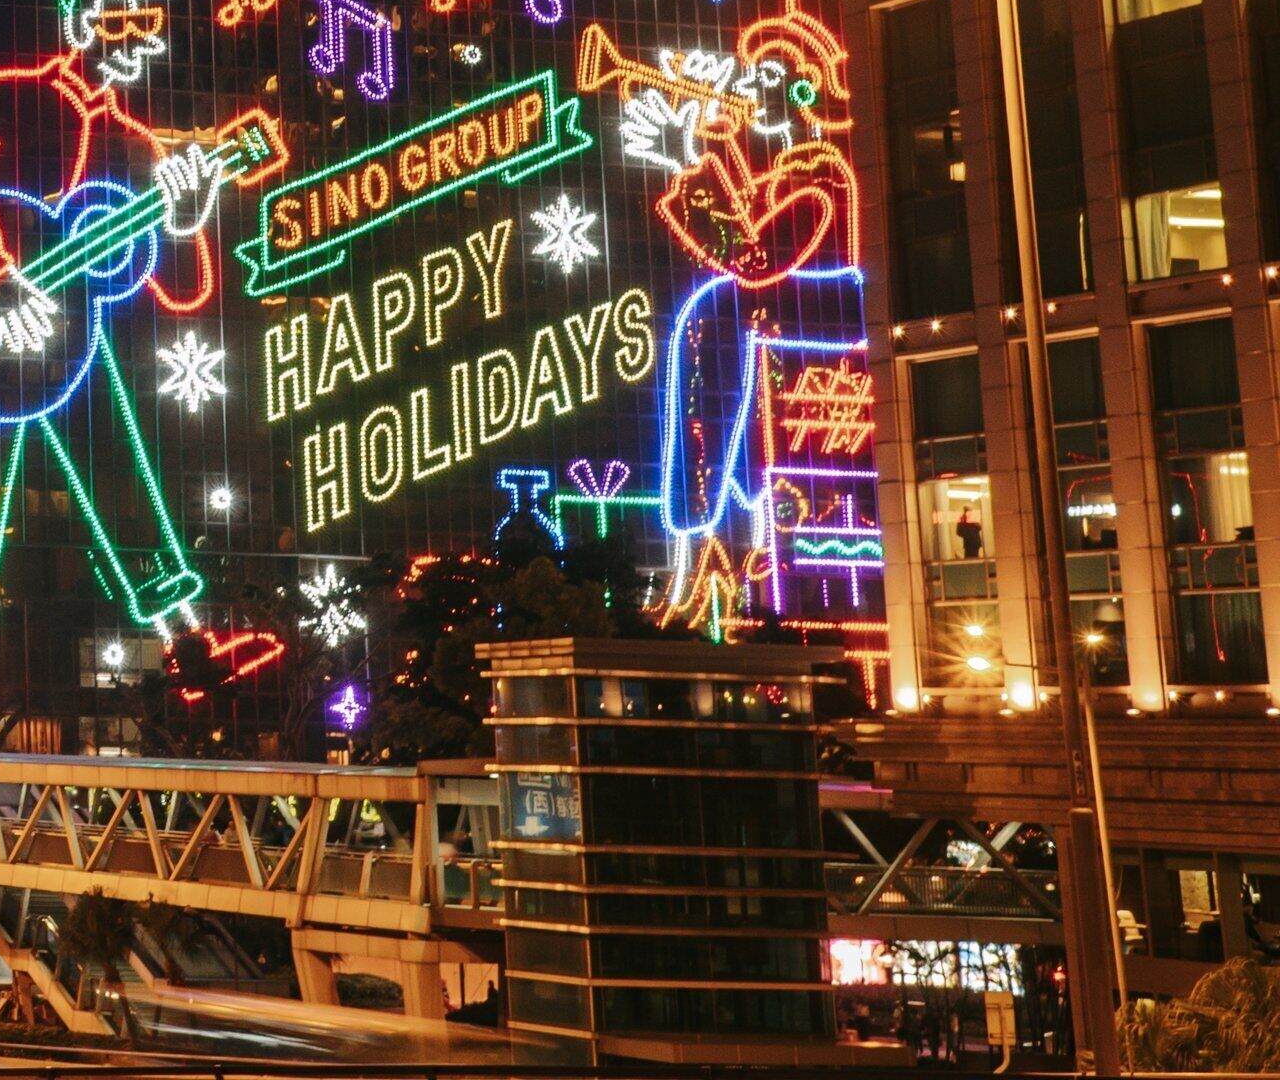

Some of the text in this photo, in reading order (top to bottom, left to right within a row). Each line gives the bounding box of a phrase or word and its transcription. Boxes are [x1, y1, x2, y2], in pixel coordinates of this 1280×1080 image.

[273, 92, 544, 249] SINO GROUP
[263, 219, 513, 422] HAPPY
[303, 288, 656, 533] HOLIDAYS
